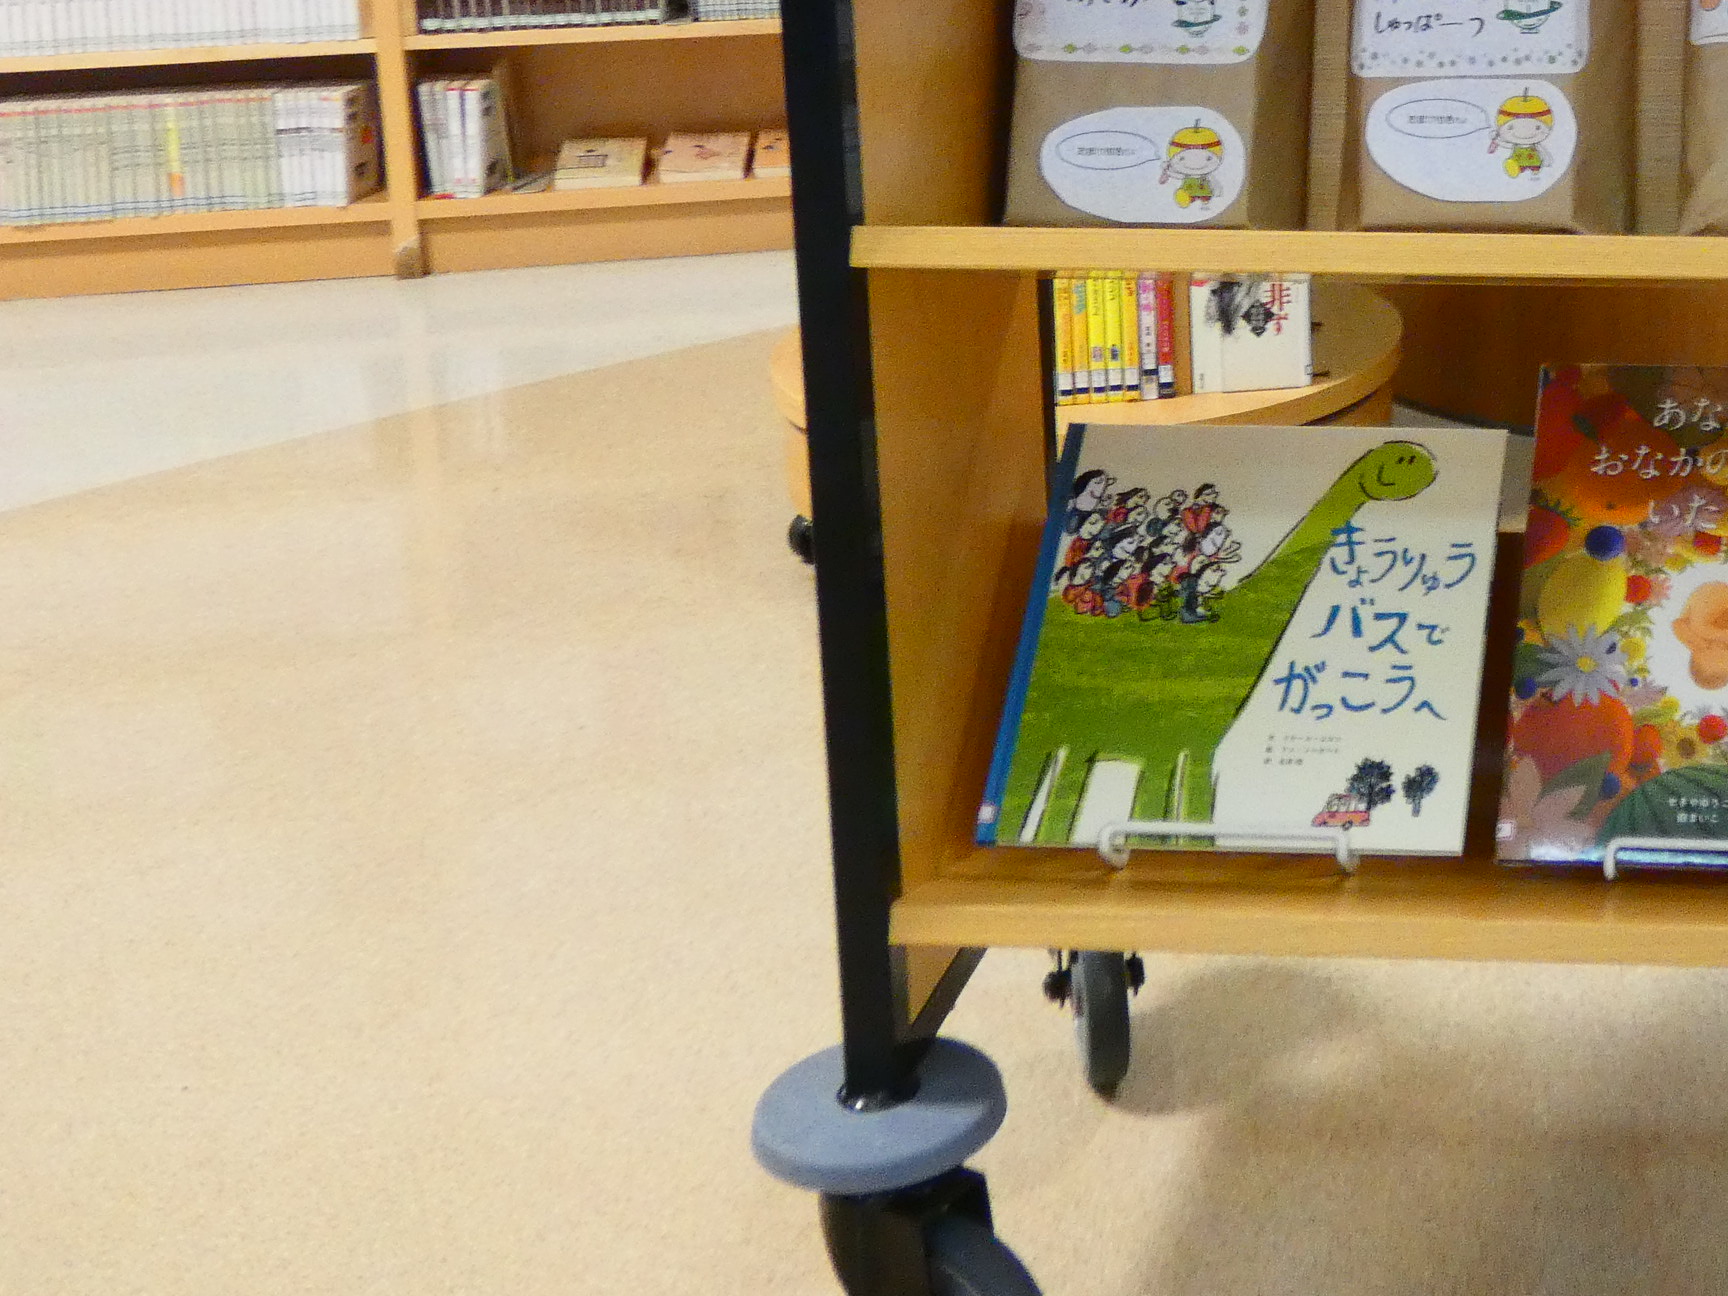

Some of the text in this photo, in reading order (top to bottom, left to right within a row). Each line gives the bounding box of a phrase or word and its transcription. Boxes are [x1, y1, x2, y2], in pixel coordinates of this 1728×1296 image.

[1329, 519, 1477, 596] きょうりゅう
[1310, 597, 1451, 655] バスで
[1273, 660, 1449, 722] がっこうへ
